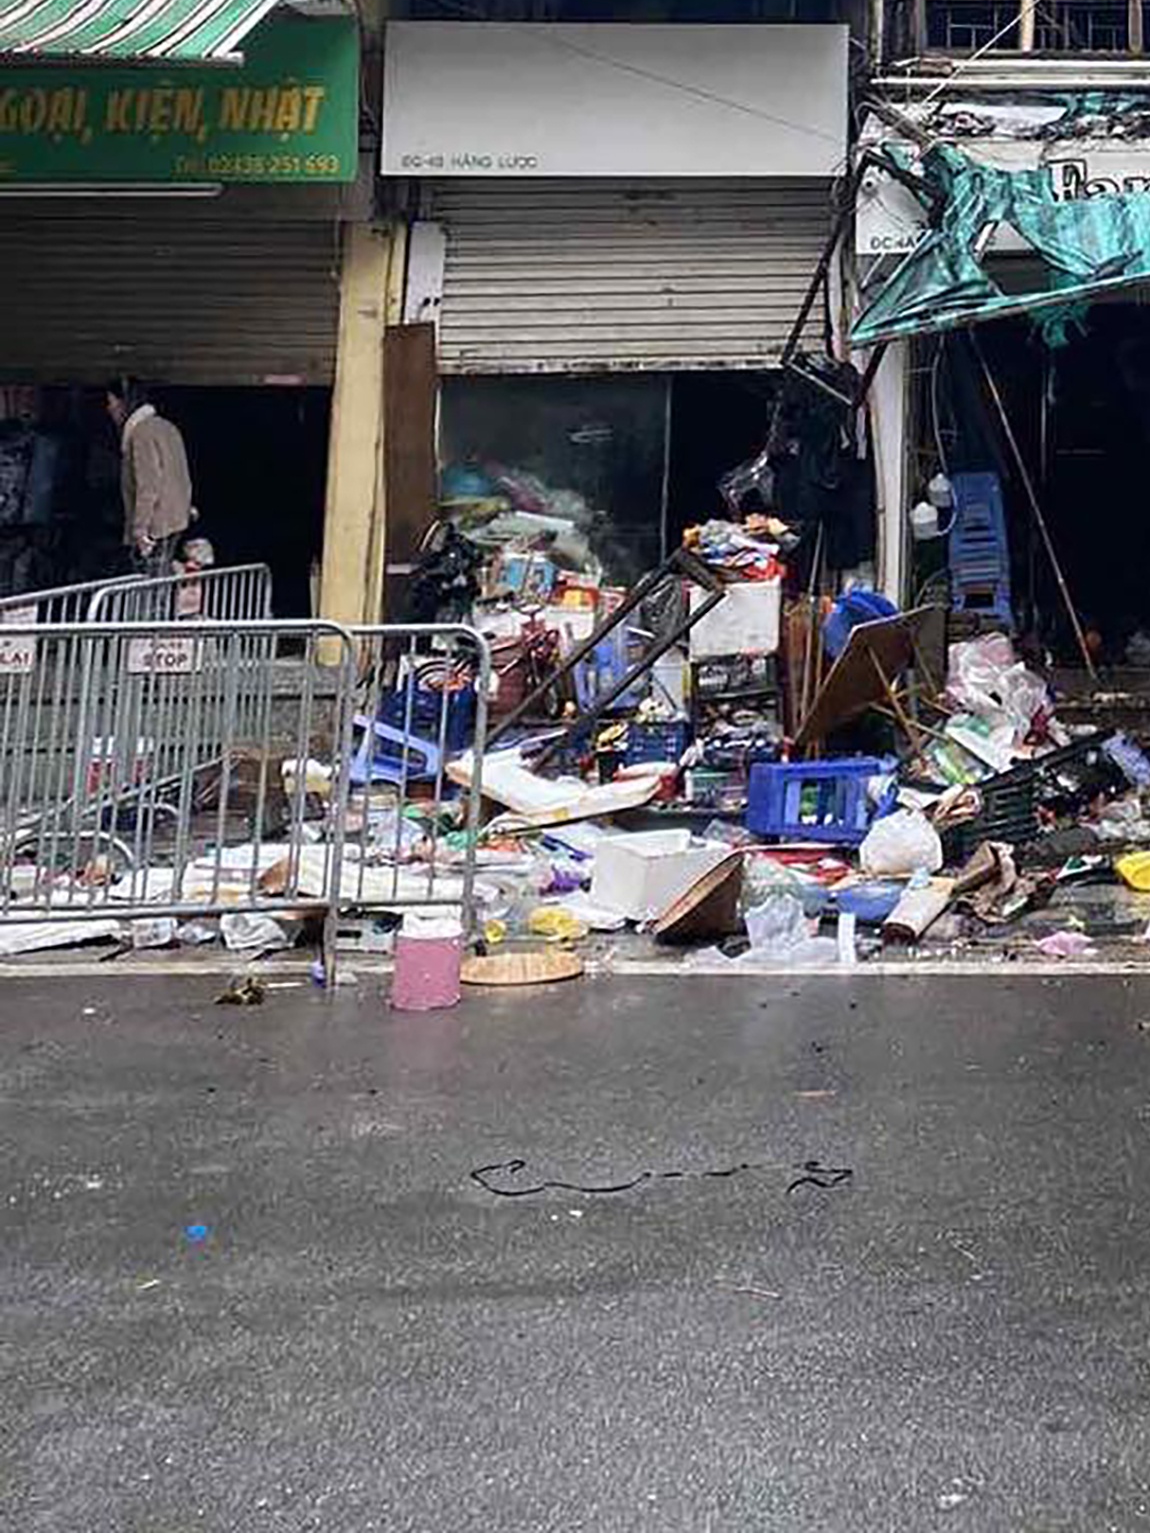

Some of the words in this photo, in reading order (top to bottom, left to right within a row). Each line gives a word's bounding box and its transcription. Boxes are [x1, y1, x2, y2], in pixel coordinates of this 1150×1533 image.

[104, 79, 205, 145] KIỆN,
[219, 77, 325, 142] NHẬT
[143, 652, 188, 665] STOP
